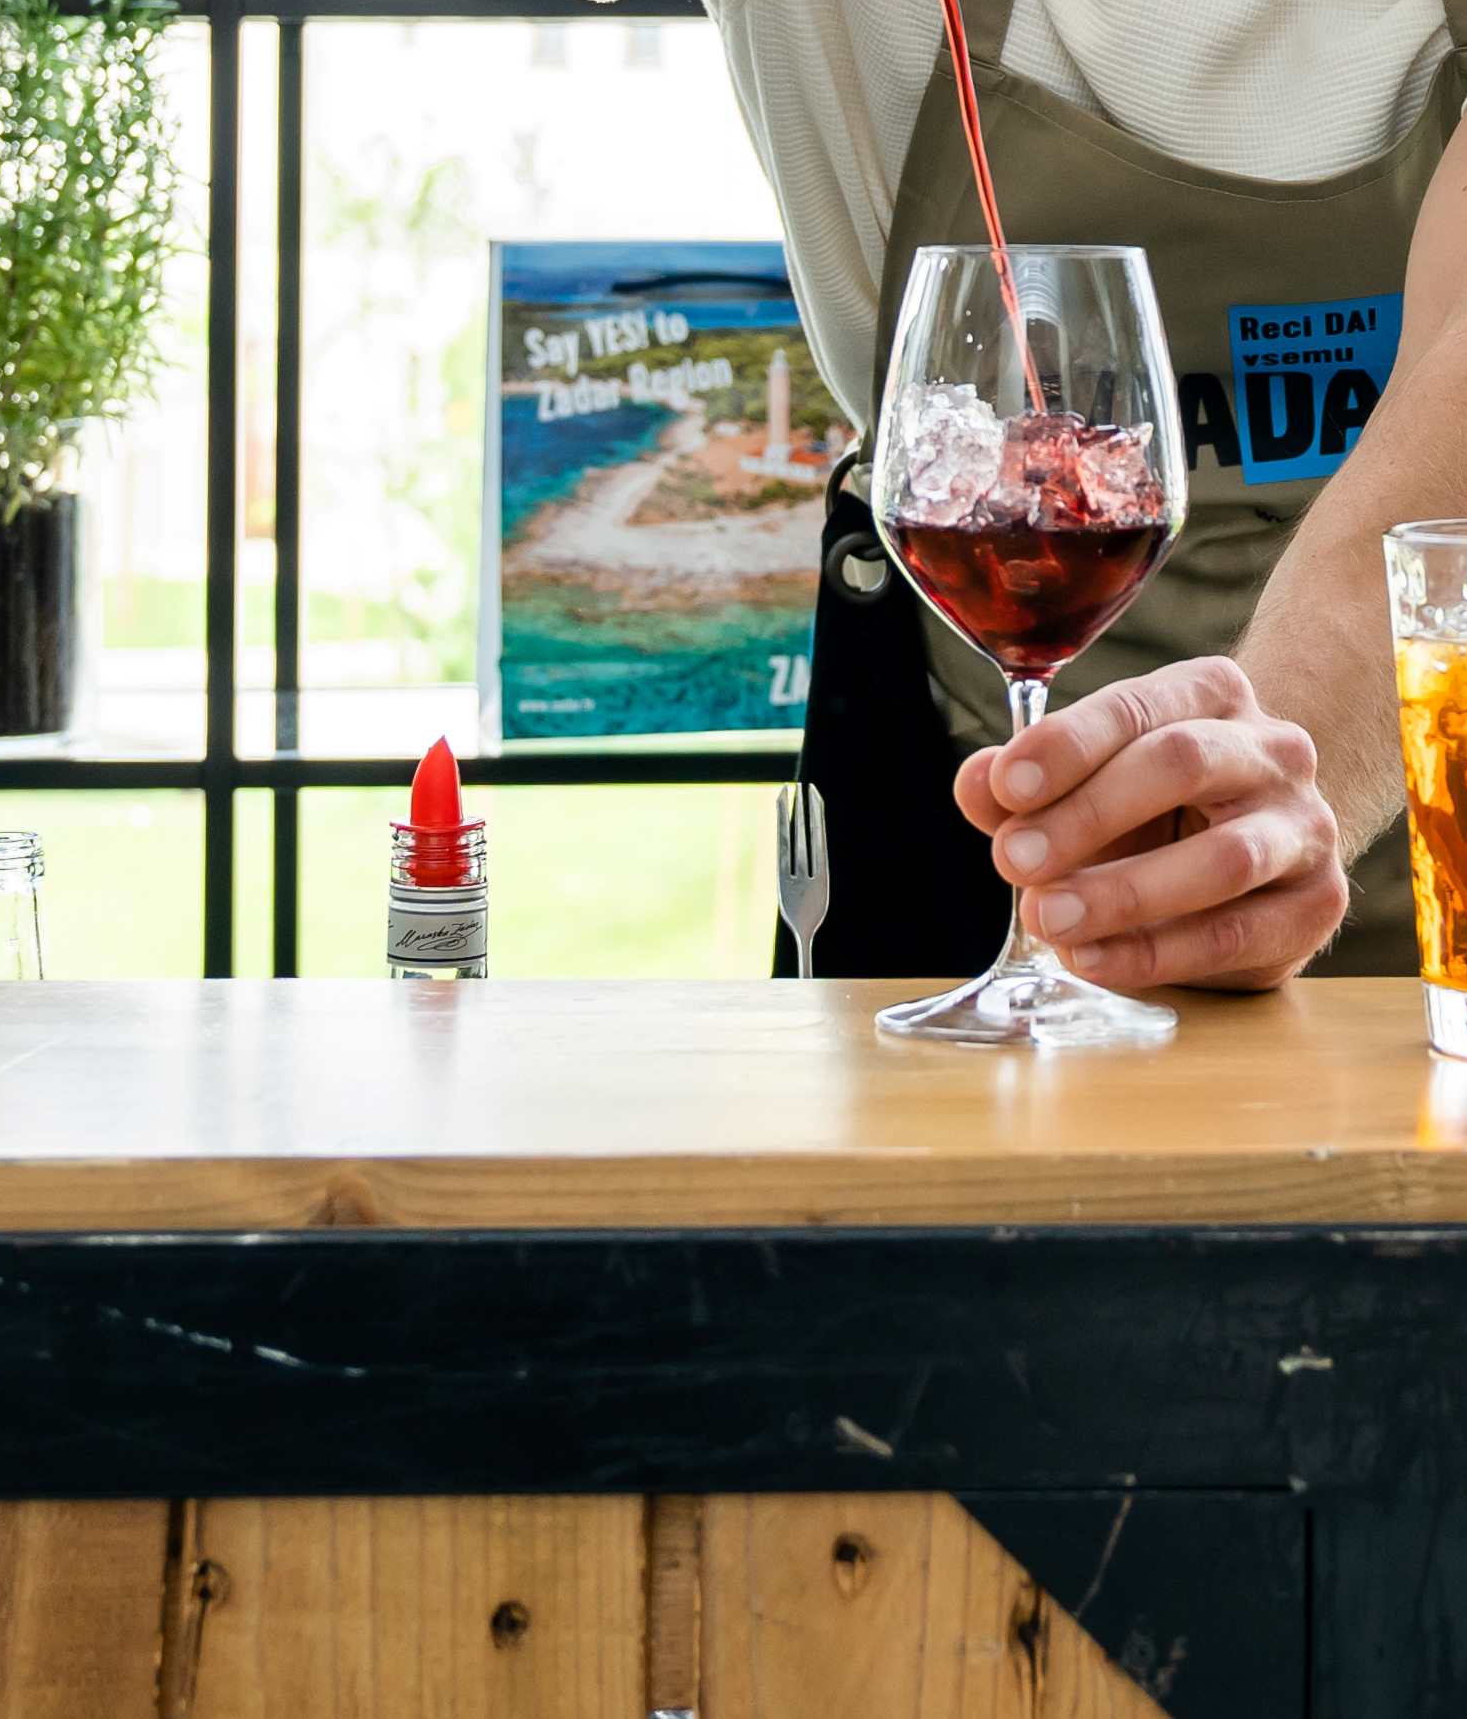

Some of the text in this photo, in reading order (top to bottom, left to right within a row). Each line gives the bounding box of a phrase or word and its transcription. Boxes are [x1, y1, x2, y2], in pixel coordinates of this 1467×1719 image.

[523, 310, 690, 378] Say YES! to
[1239, 308, 1378, 342] Reci DA!
[1241, 346, 1355, 368] vsemu
[536, 356, 734, 423] Zadar Region
